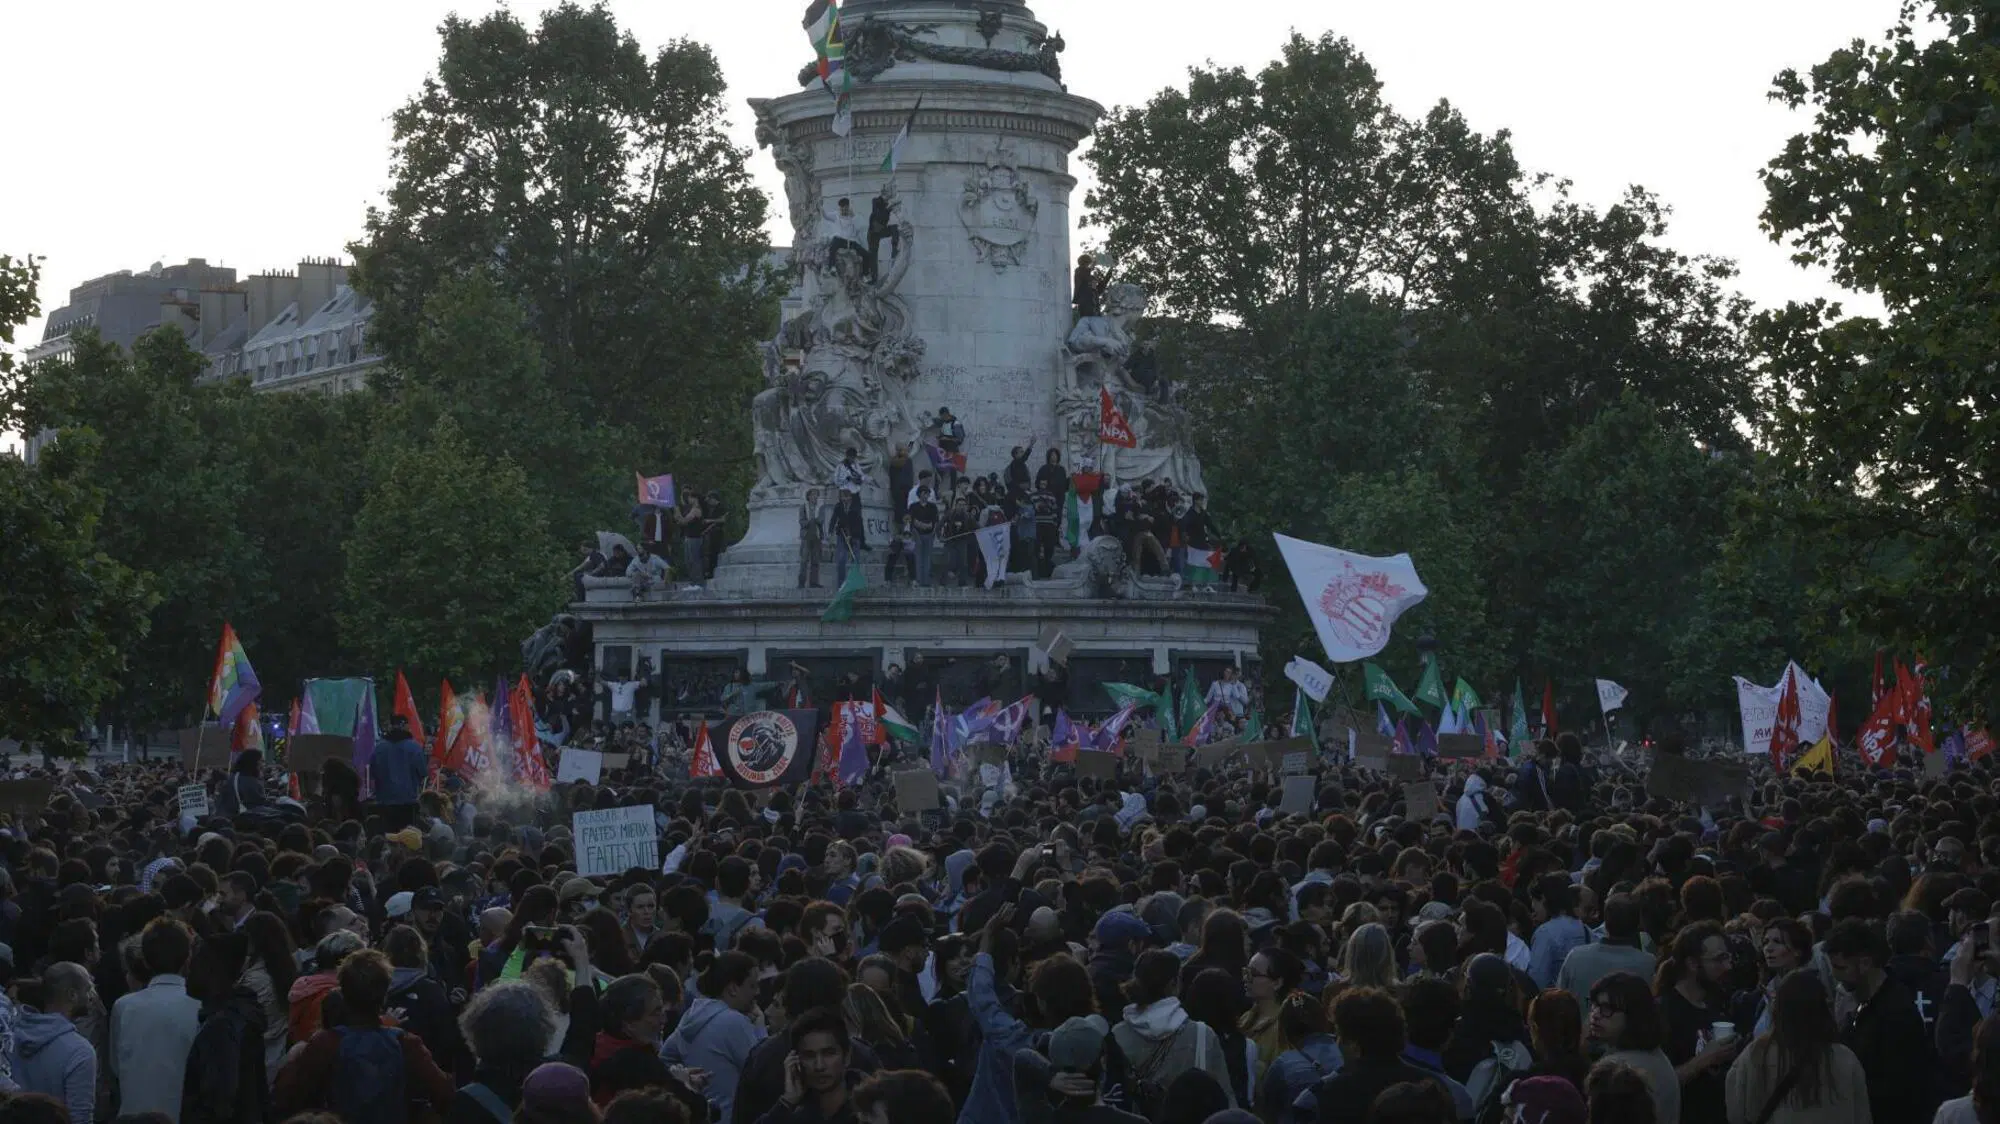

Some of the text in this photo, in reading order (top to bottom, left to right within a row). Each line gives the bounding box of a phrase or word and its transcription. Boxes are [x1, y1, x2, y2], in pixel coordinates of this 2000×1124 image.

[1101, 423, 1129, 441] NPA
[582, 820, 650, 845] FAITES MIEUX
[587, 840, 658, 873] FAITES VITE
